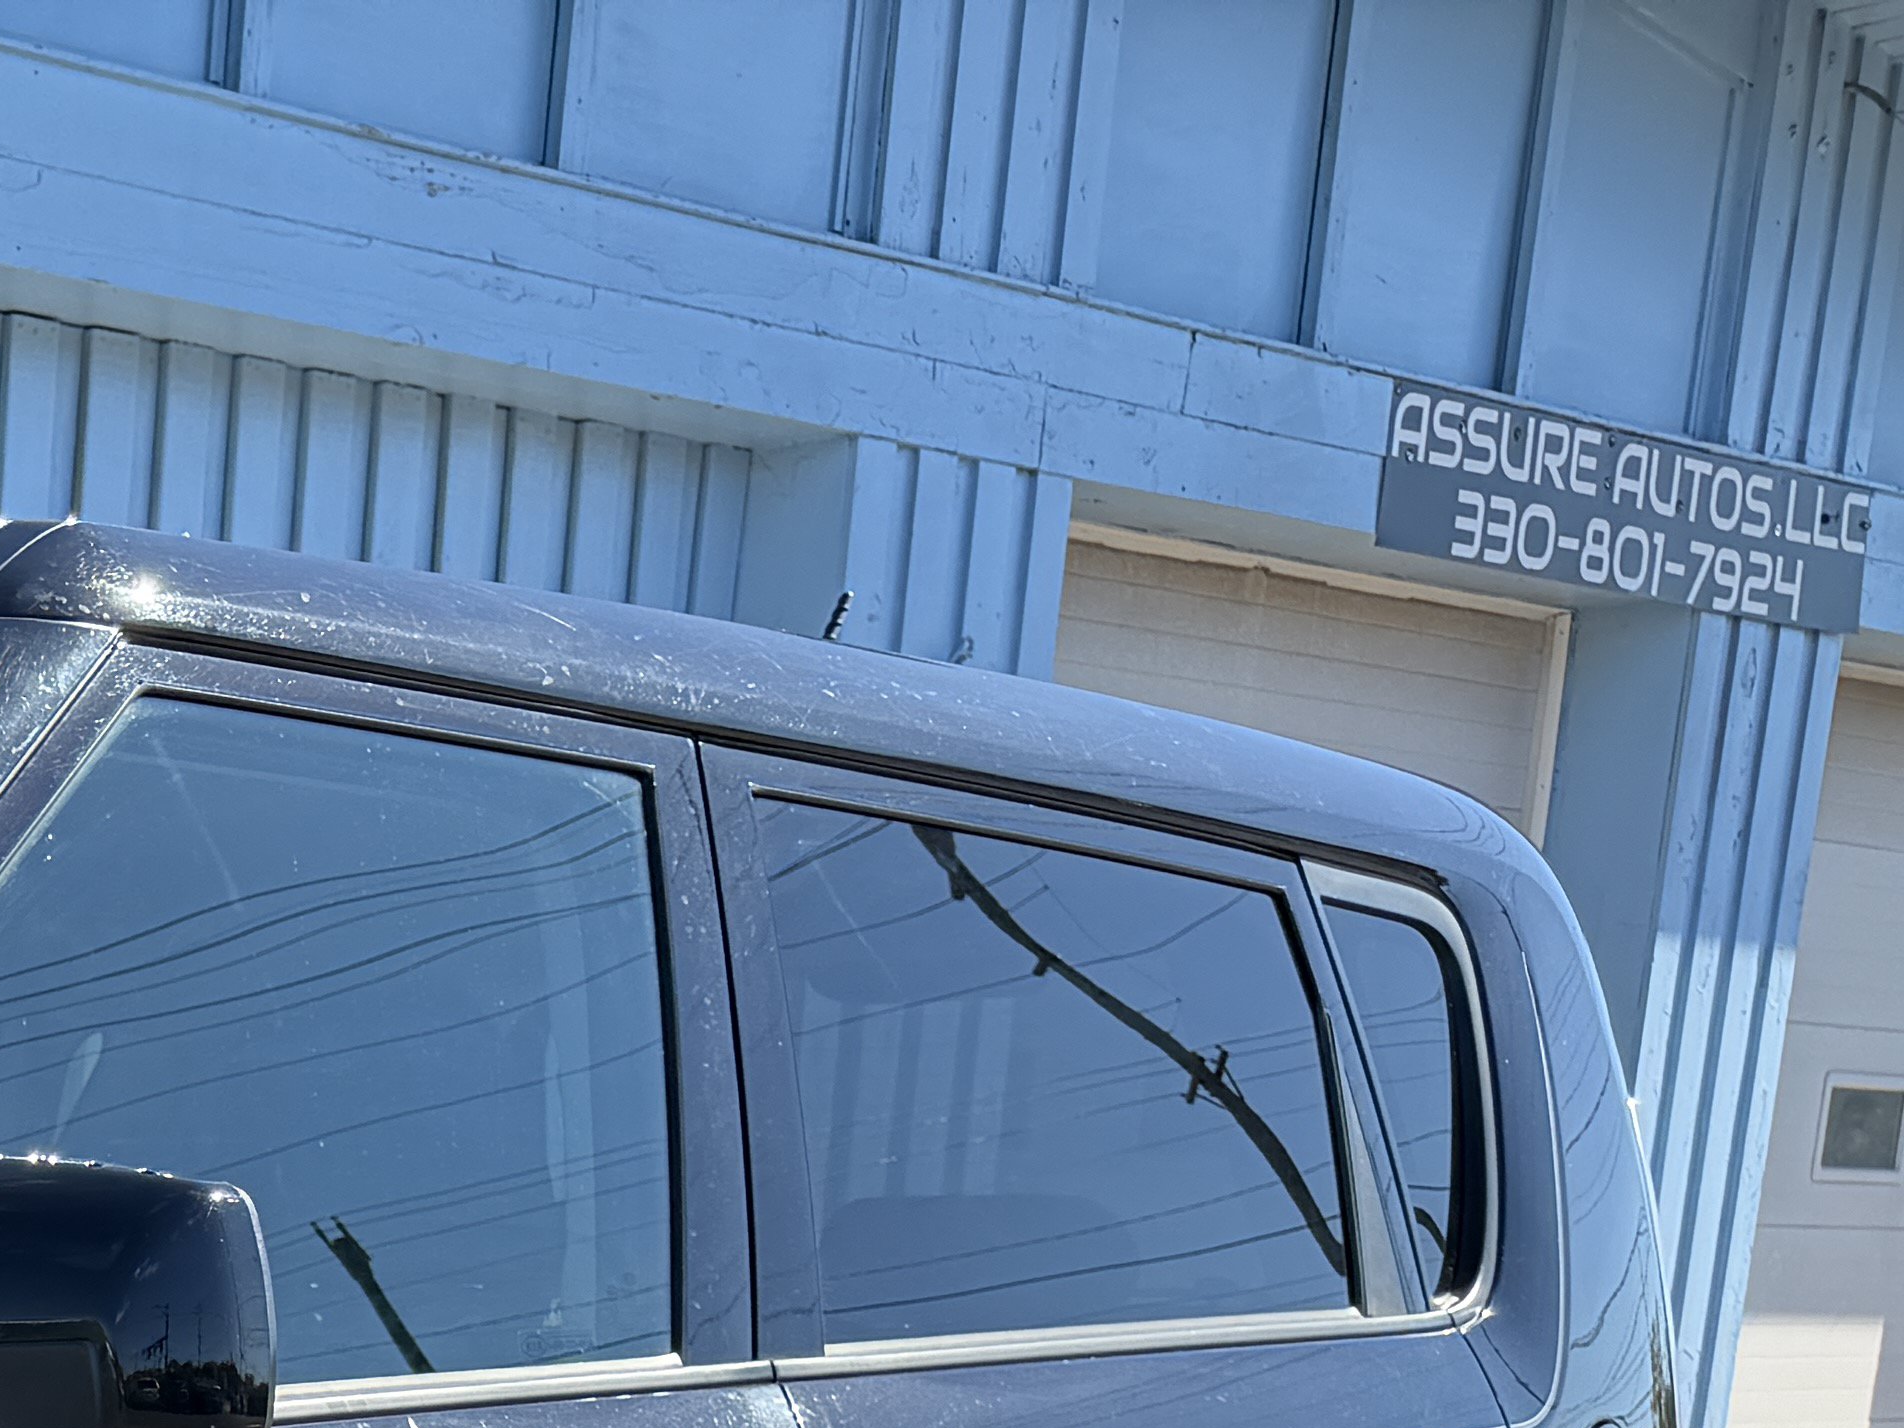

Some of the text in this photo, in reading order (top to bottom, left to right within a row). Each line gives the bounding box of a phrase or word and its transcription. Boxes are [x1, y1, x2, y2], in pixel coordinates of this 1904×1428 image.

[1392, 392, 1870, 553] ASSURE AUTOS LLC
[1451, 490, 1804, 622] 330-801-7924
